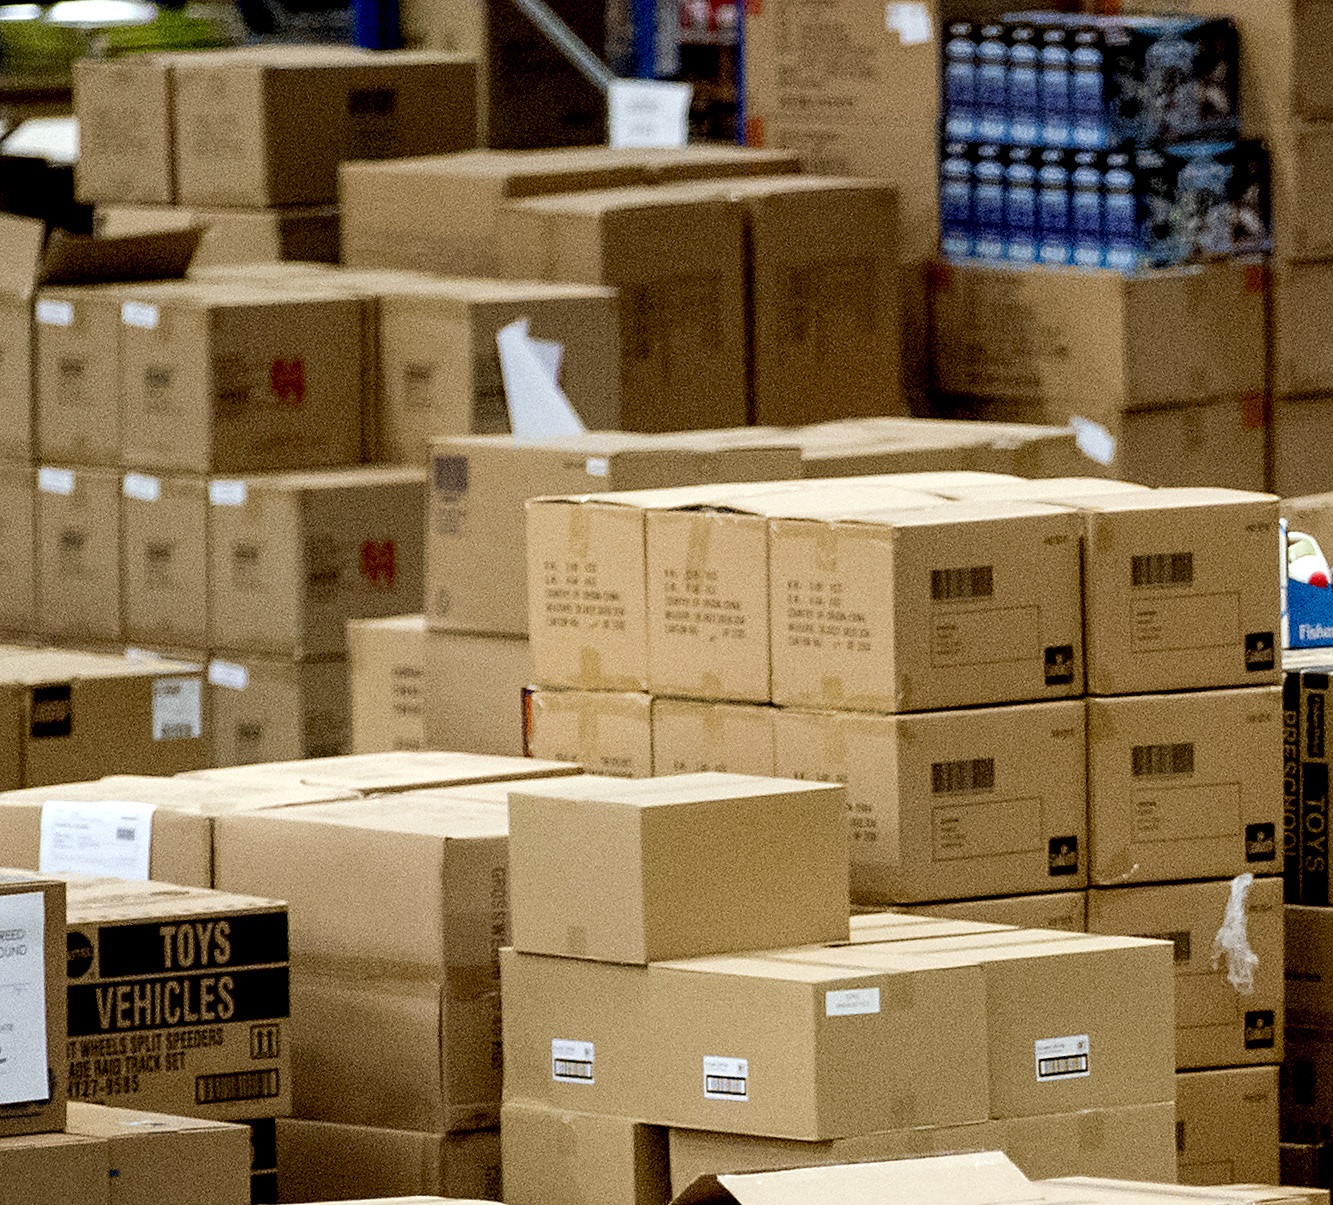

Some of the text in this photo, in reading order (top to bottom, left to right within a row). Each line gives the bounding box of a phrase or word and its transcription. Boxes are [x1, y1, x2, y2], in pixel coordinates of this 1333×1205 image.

[1304, 797, 1325, 873] TOYS
[160, 920, 232, 969] TOYS
[95, 975, 236, 1030] VEHICLES
